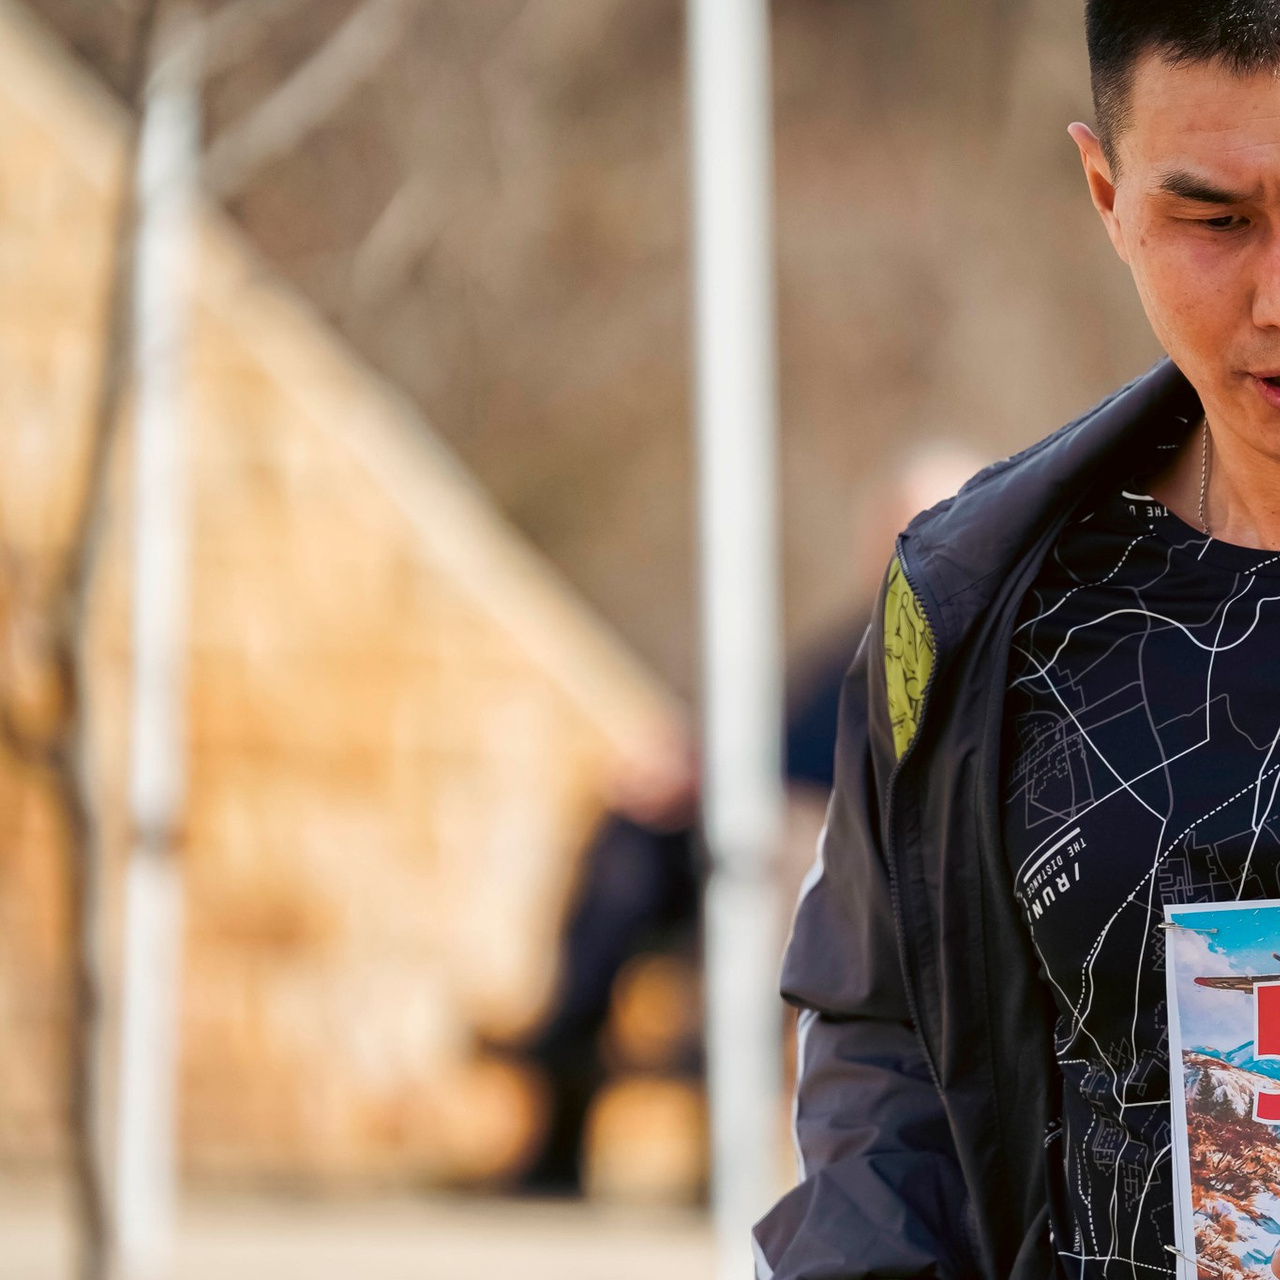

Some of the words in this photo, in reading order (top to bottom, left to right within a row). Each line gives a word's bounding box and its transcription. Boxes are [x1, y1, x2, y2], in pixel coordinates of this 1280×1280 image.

[1146, 506, 1169, 517] THE
[1066, 837, 1087, 858] THE
[1026, 854, 1064, 898] DISTANCE
